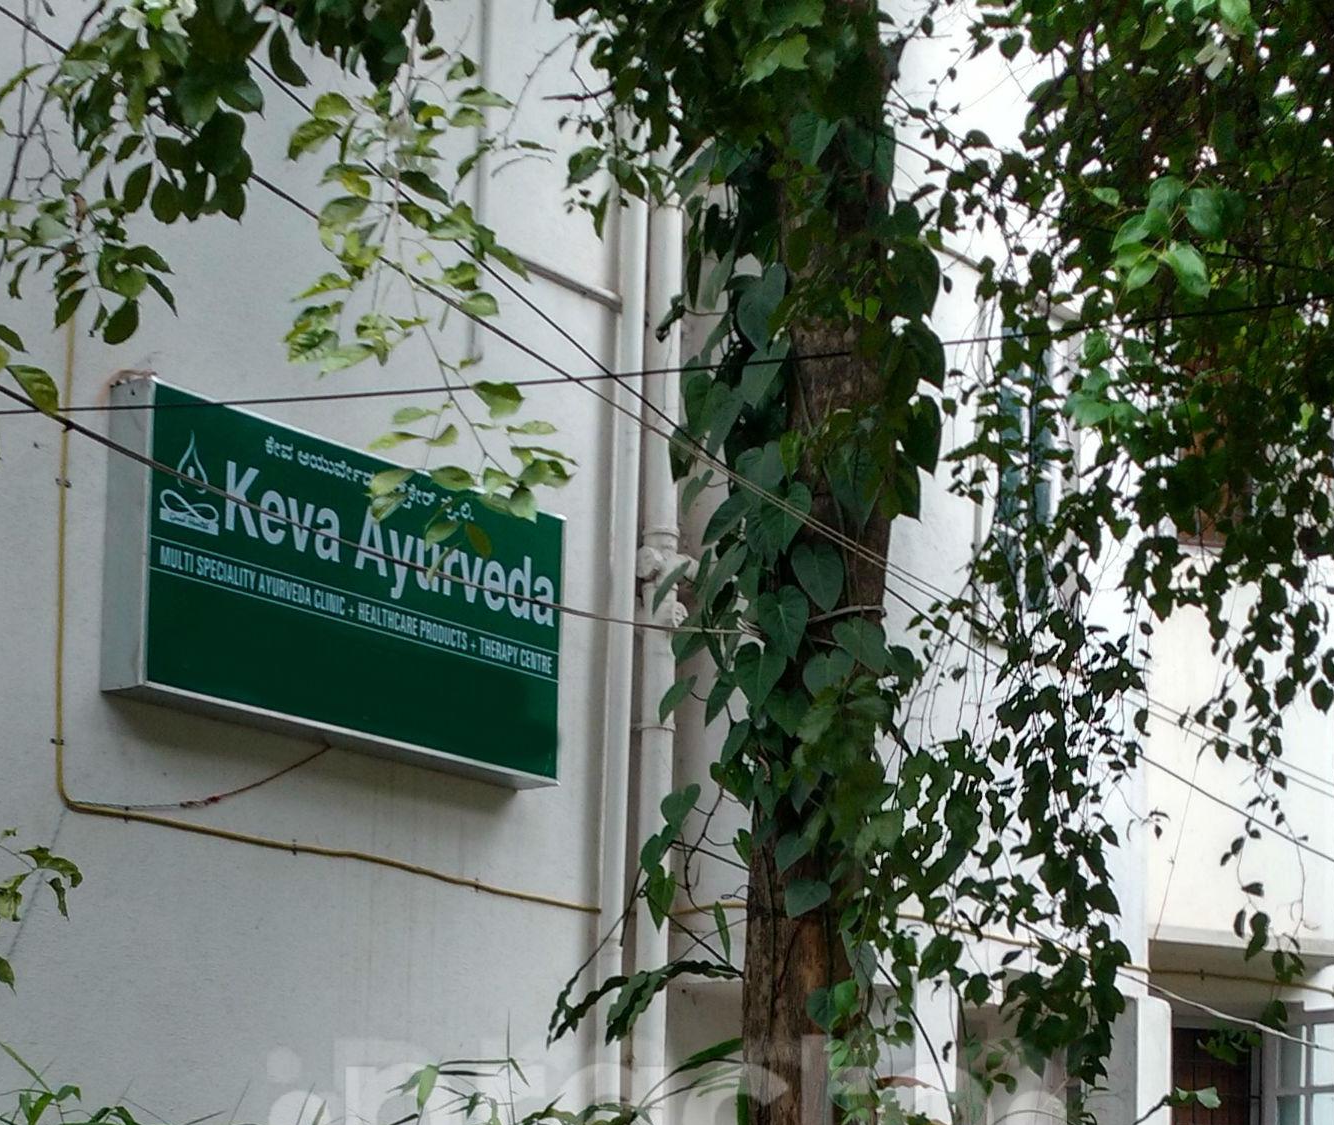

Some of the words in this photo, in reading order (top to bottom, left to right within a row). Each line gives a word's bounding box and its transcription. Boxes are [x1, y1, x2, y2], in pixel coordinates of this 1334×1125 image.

[160, 545, 194, 573] MULTI
[196, 555, 256, 590] SPECIALITY
[258, 573, 312, 606] AYURVEDA
[314, 589, 346, 616] CLINIC
[358, 602, 418, 636] HEALTHCARE
[420, 620, 468, 650] PRODUCTS
[479, 636, 519, 664] THERAPY
[520, 648, 553, 674] CENTRE
[225, 461, 340, 563] Keva
[354, 505, 555, 628] Ayurveda
